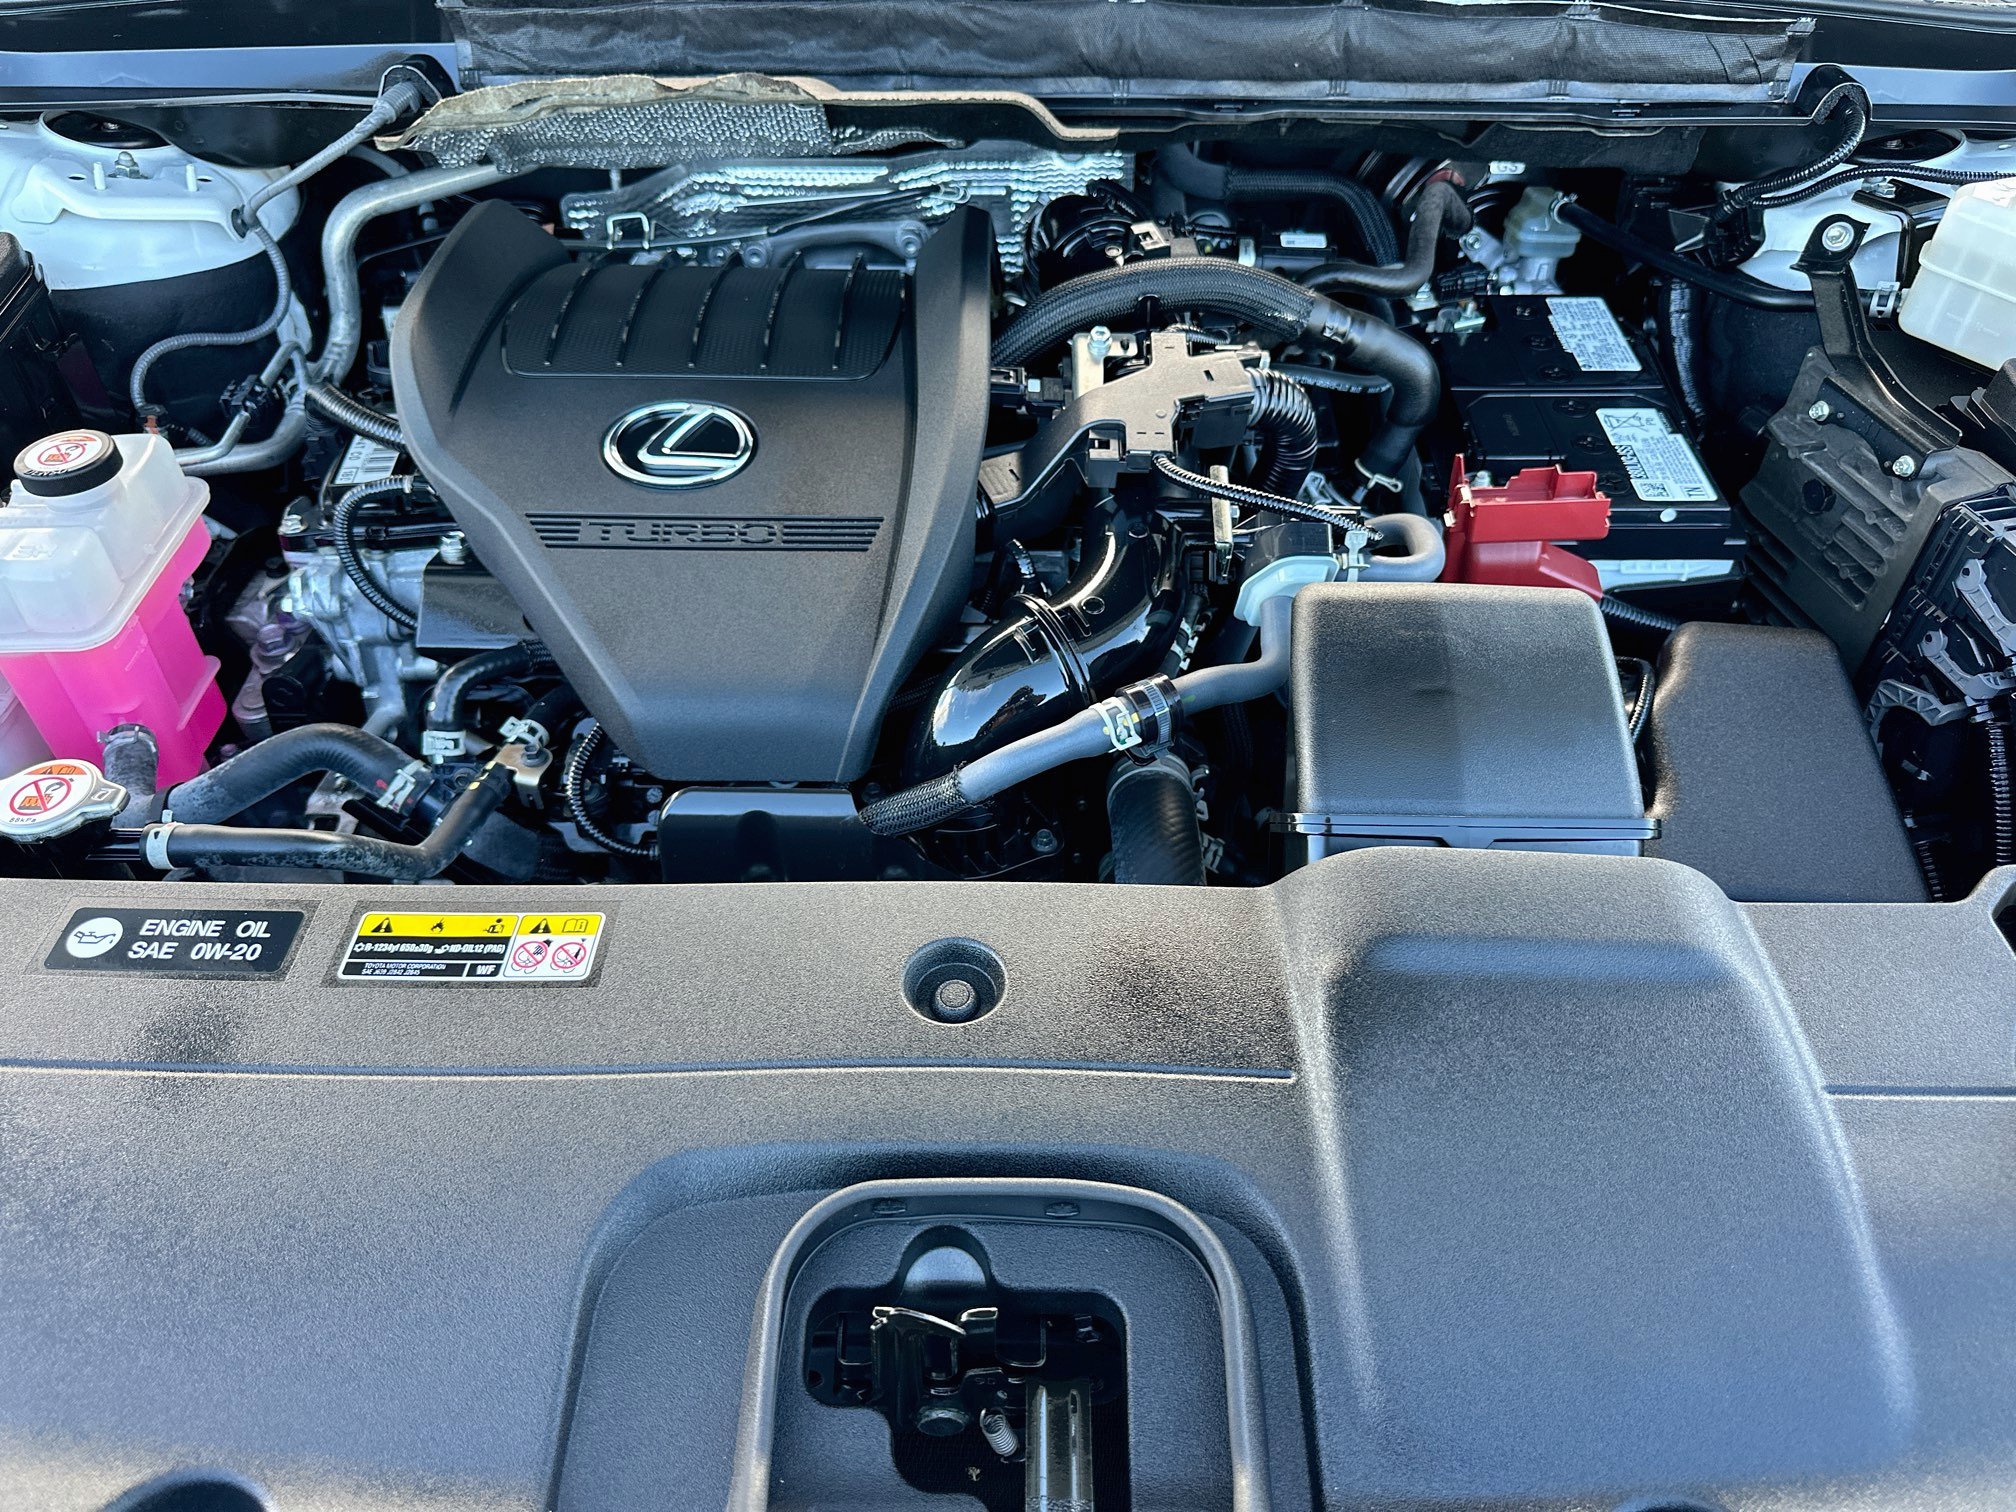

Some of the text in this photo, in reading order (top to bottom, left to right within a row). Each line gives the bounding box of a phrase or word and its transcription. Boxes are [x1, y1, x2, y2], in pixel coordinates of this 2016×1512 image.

[587, 521, 778, 545] TURBO
[139, 919, 272, 938] ENGINE OIL
[127, 941, 263, 961] SAE 0W-20
[476, 964, 496, 975] WF
